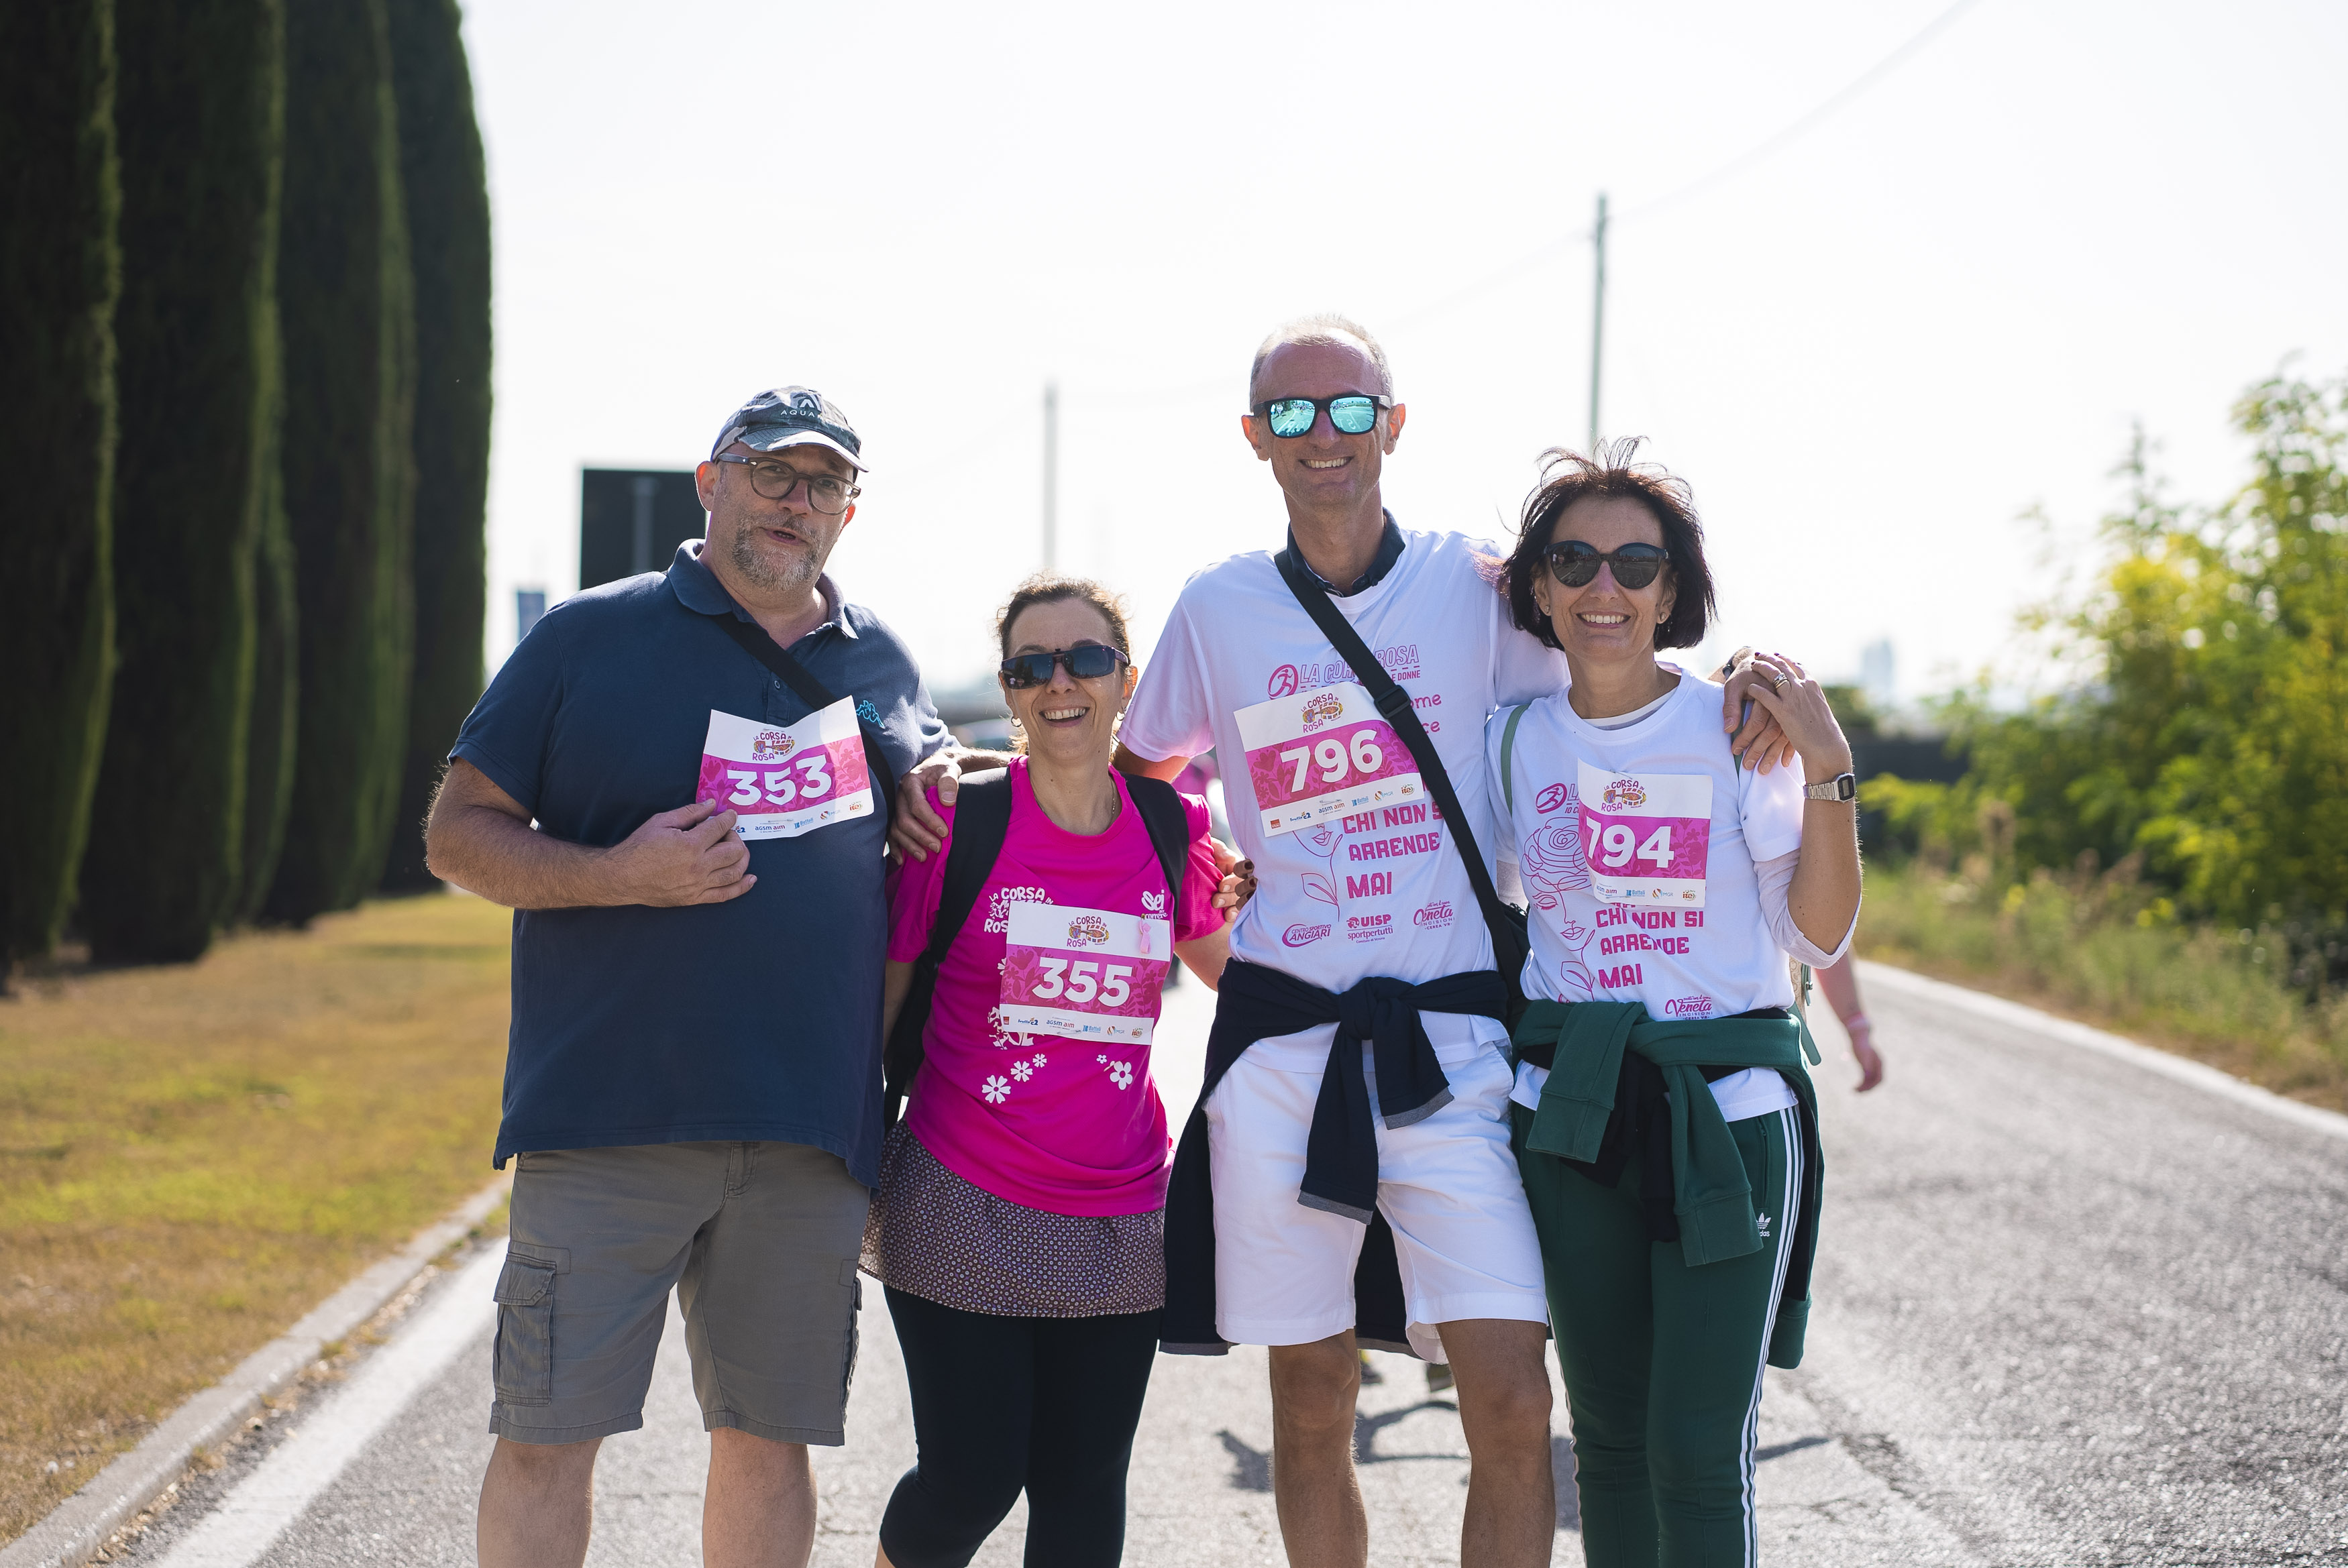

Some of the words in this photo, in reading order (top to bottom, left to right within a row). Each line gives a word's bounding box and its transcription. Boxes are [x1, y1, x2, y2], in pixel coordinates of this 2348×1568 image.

[1300, 664, 1320, 683] LA
[1375, 645, 1420, 667] ROSA
[1398, 670, 1421, 681] DONNE
[1308, 693, 1334, 708] CORSA
[1303, 719, 1324, 733] ROSA
[760, 732, 786, 740] CORSA
[753, 752, 775, 761] ROSA
[1280, 729, 1383, 793] 796
[727, 754, 832, 805] 353
[1611, 779, 1639, 789] CORSA
[1601, 802, 1622, 812] ROSA
[1342, 811, 1377, 834] CHI
[1383, 803, 1426, 827] NON
[1432, 801, 1444, 820] S
[1348, 832, 1440, 861] ARRENDE
[1586, 815, 1674, 869] 794
[1346, 872, 1391, 899] MAI
[989, 893, 999, 901] LA
[1001, 887, 1045, 900] CORSA
[984, 918, 1008, 933] ROS
[1076, 916, 1102, 924] CORSA
[1361, 913, 1391, 927] UISP
[1596, 908, 1627, 928] CHI
[1632, 911, 1676, 929] NON
[1685, 911, 1703, 927] SI
[1289, 928, 1331, 941] ANGIARI
[1348, 926, 1393, 940] sportpertutti
[1067, 938, 1087, 947] ROSA
[1032, 957, 1132, 1007] 355
[1598, 964, 1643, 989] MAI
[1665, 999, 1712, 1017] Veneta
